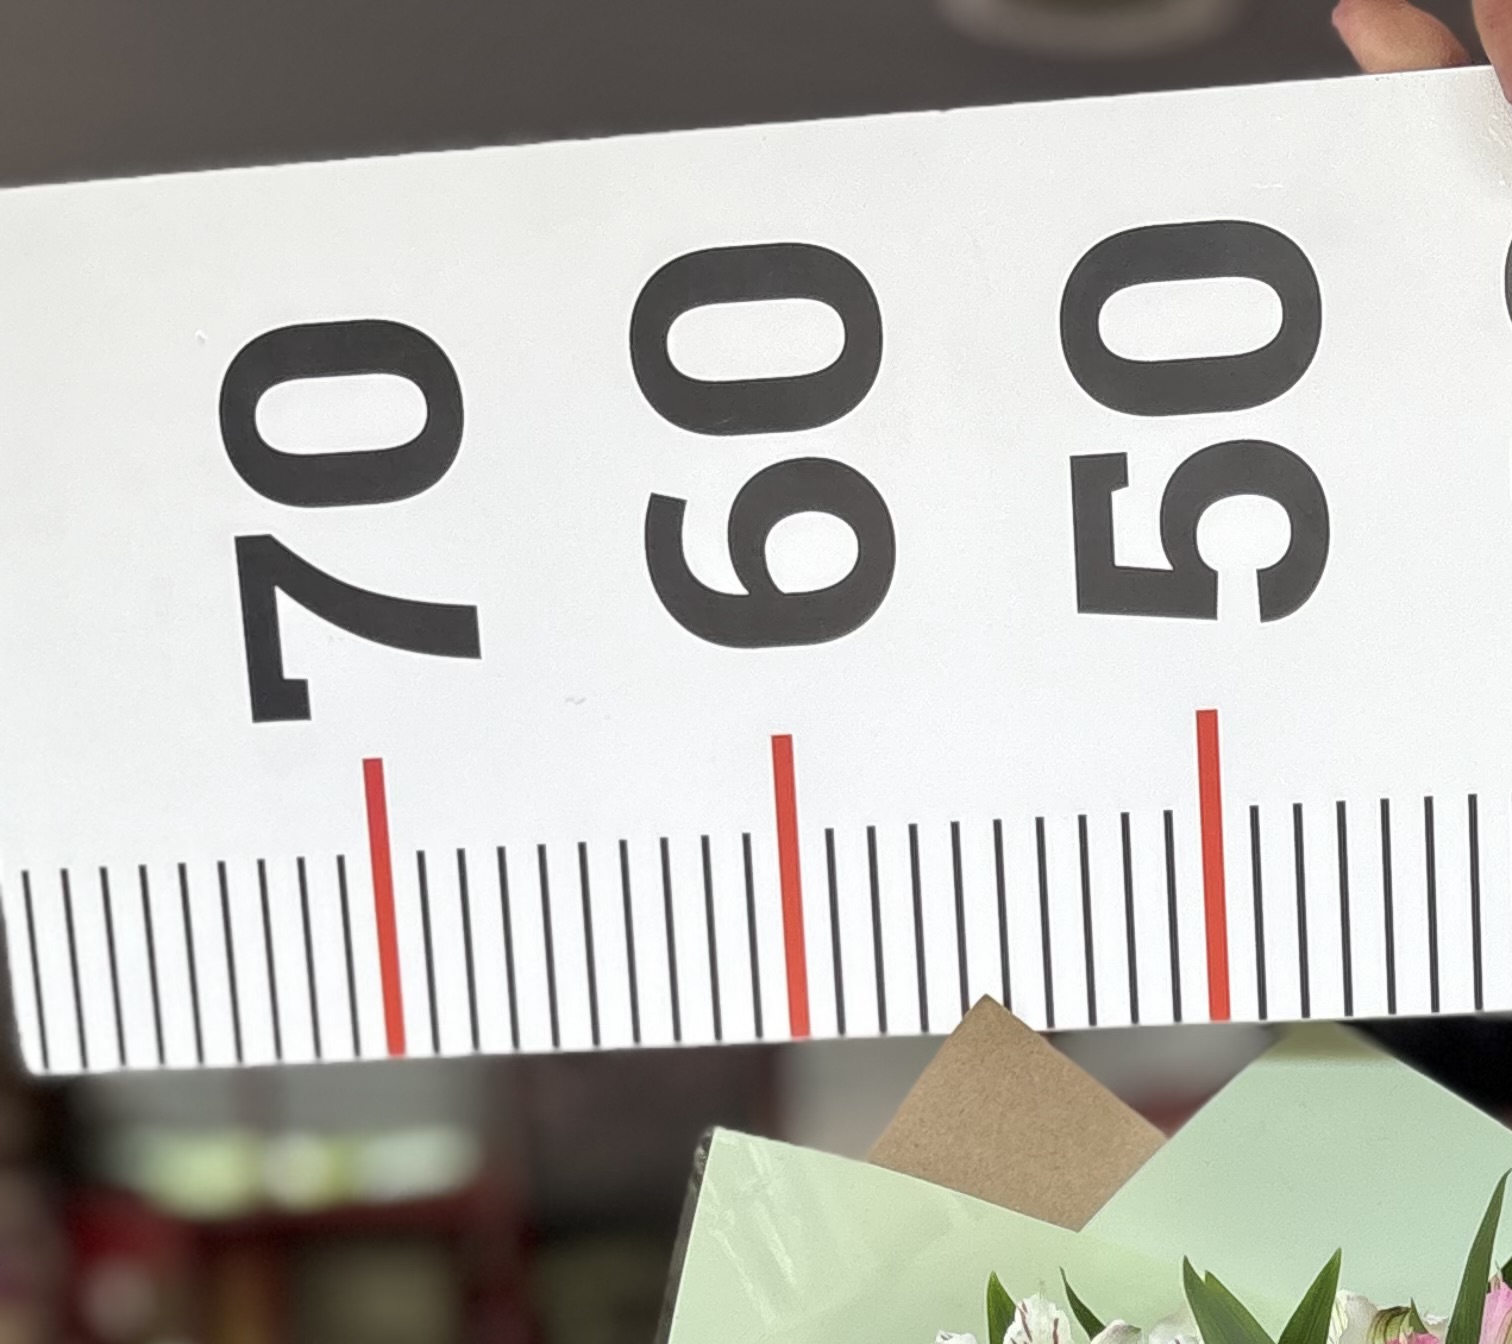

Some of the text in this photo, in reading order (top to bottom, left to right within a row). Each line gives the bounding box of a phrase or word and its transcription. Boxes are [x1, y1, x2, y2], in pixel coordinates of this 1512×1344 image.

[219, 319, 481, 723] 70
[630, 242, 896, 648] 60
[1060, 220, 1330, 622] 50
